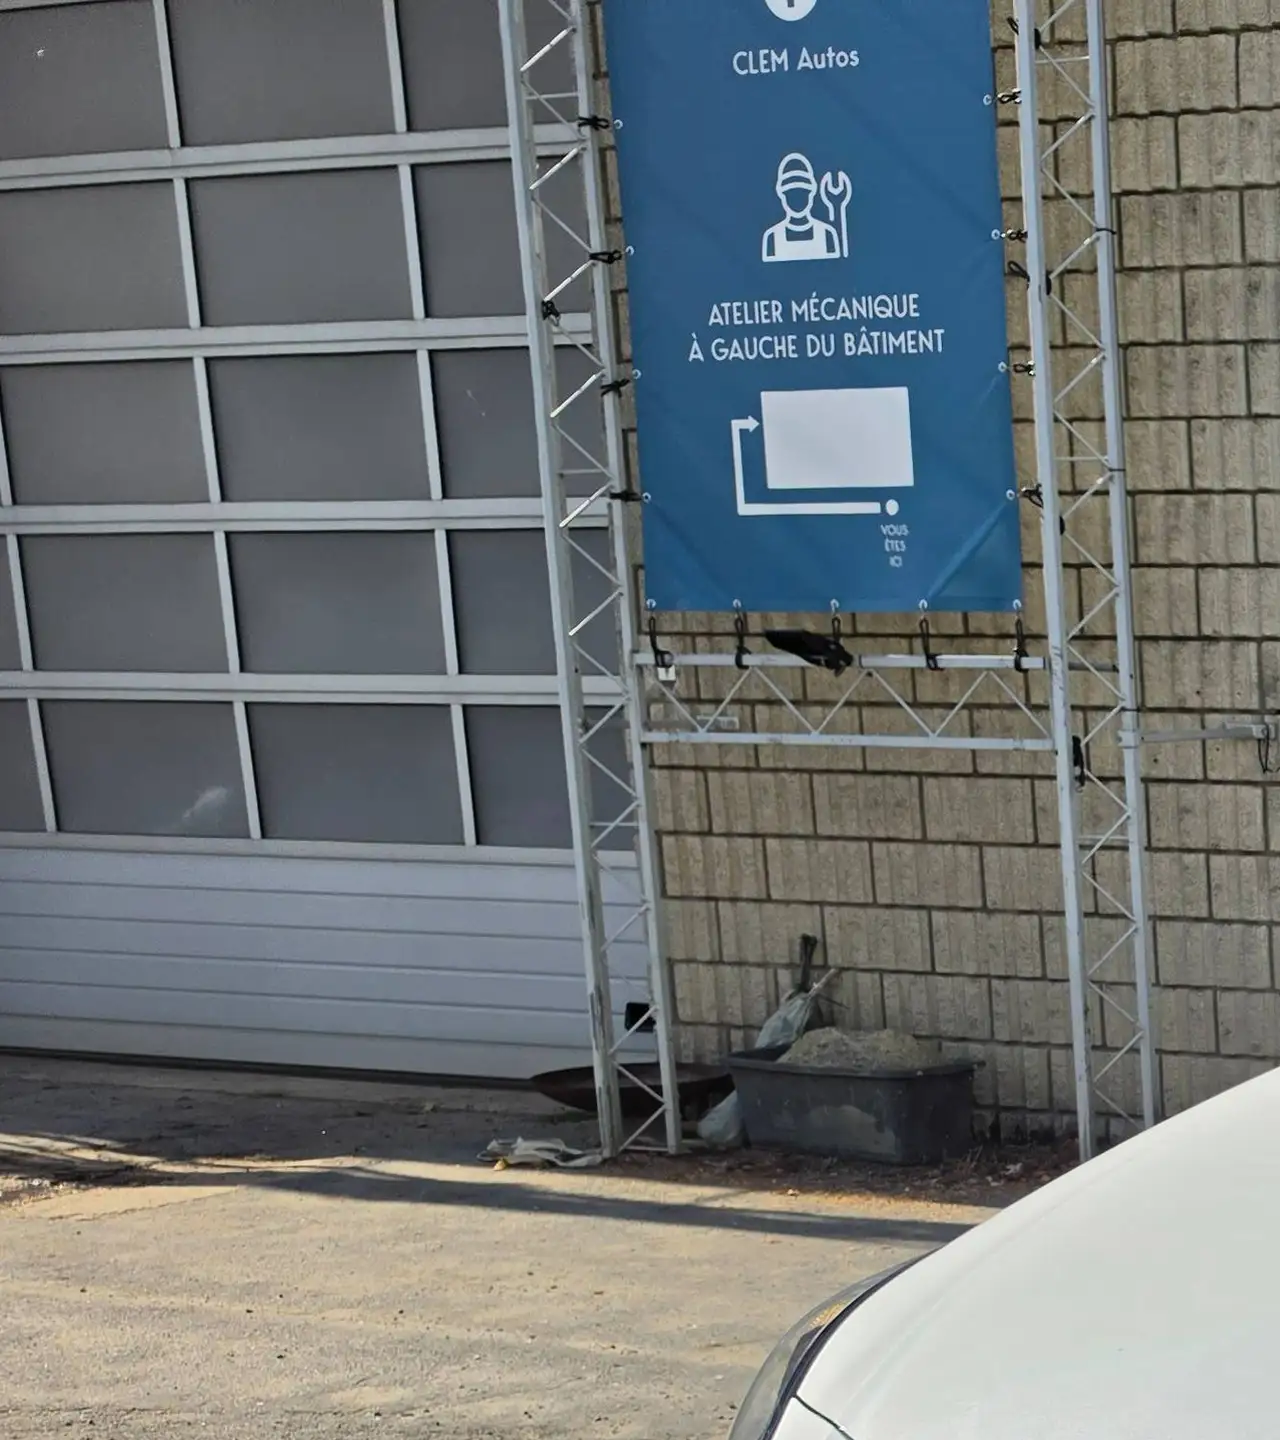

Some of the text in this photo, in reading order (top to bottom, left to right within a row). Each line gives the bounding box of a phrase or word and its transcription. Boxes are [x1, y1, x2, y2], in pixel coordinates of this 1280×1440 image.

[732, 46, 860, 75] CLEM Autos
[708, 292, 920, 327] ATELIER MÉCANIQUE
[688, 326, 945, 363] À GAUCHE DU BÂTIMENT
